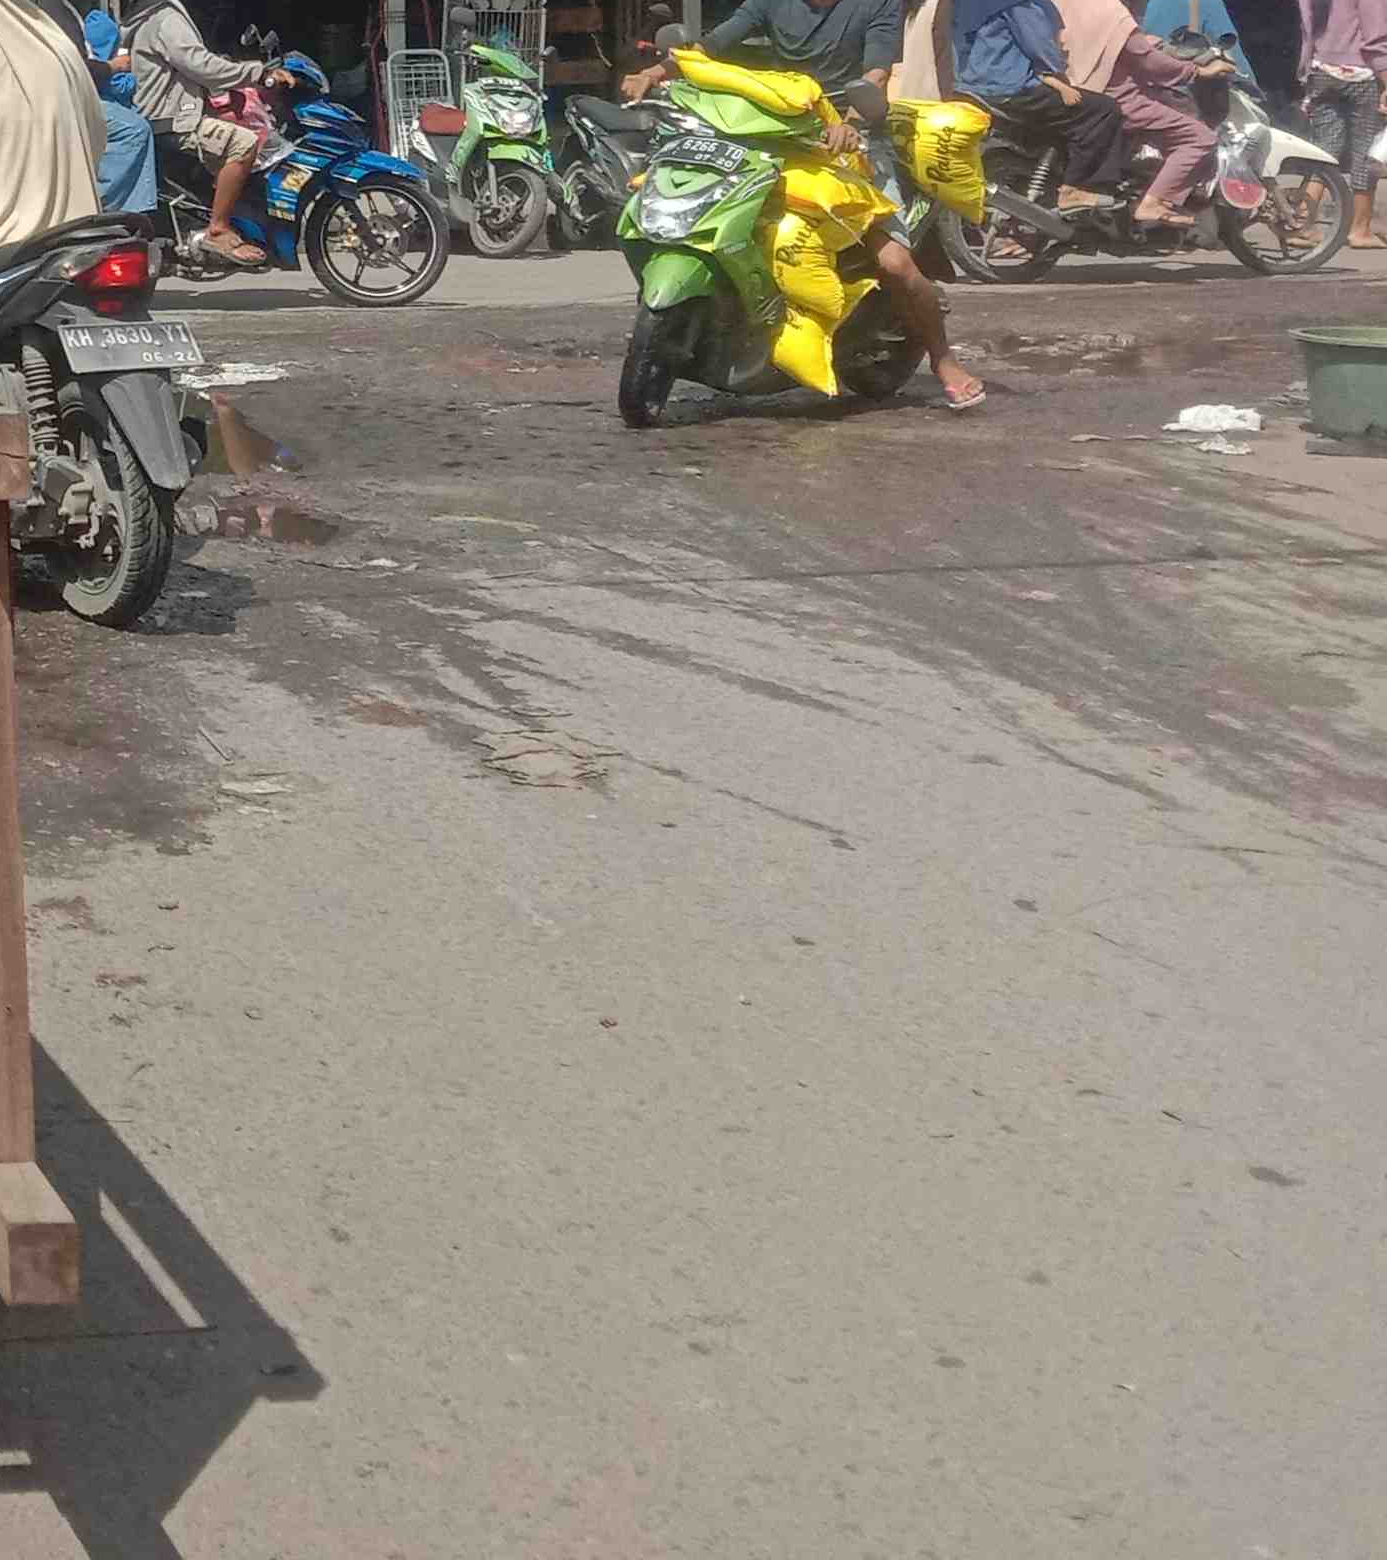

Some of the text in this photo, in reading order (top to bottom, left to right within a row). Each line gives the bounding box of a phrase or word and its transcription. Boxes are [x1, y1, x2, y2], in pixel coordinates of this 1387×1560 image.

[926, 126, 956, 183] Panda
[63, 328, 94, 348] KH
[102, 326, 153, 346] 3630
